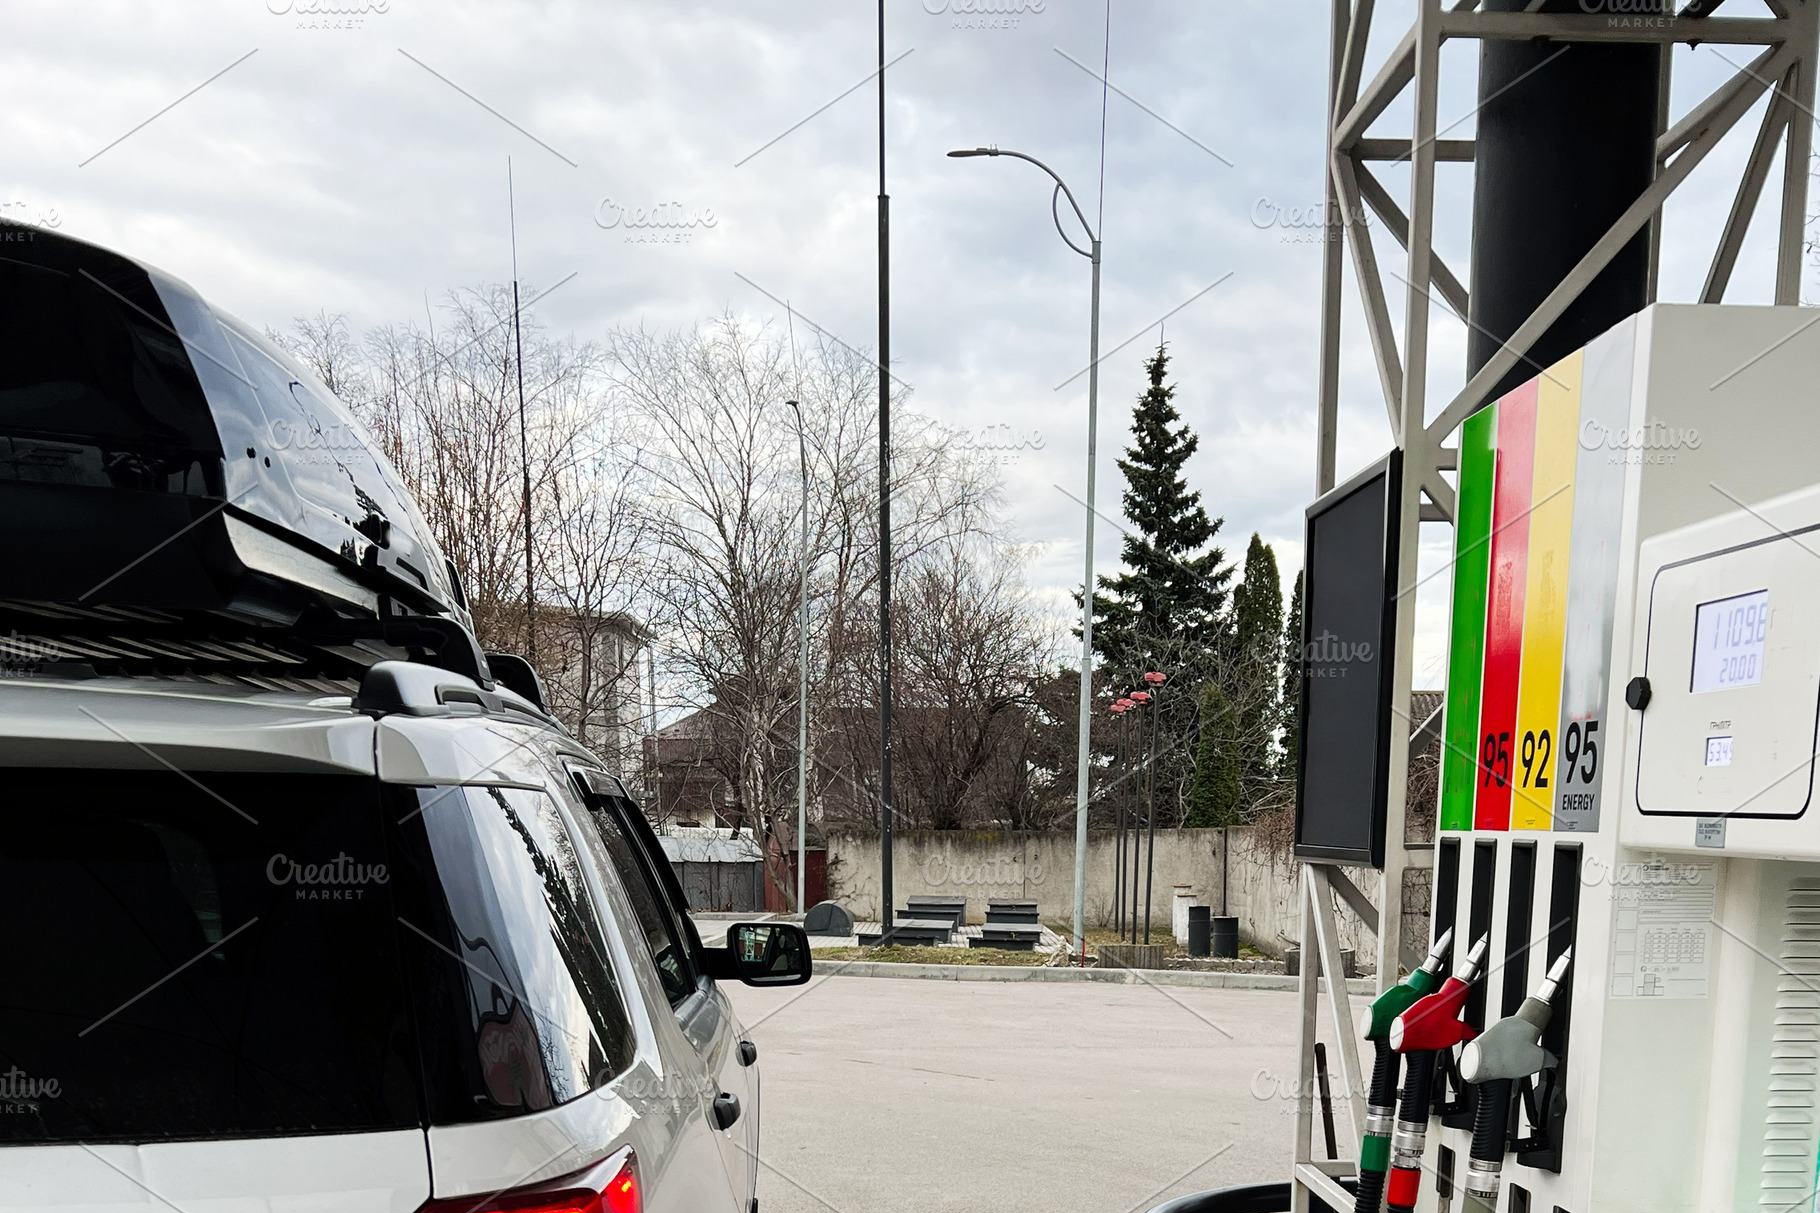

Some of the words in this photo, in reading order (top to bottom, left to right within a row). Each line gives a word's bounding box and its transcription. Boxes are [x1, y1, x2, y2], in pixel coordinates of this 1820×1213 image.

[1483, 732, 1510, 788] 95
[1521, 729, 1551, 788] 92
[1565, 720, 1599, 784] 95
[1562, 793, 1595, 811] ENERGY
